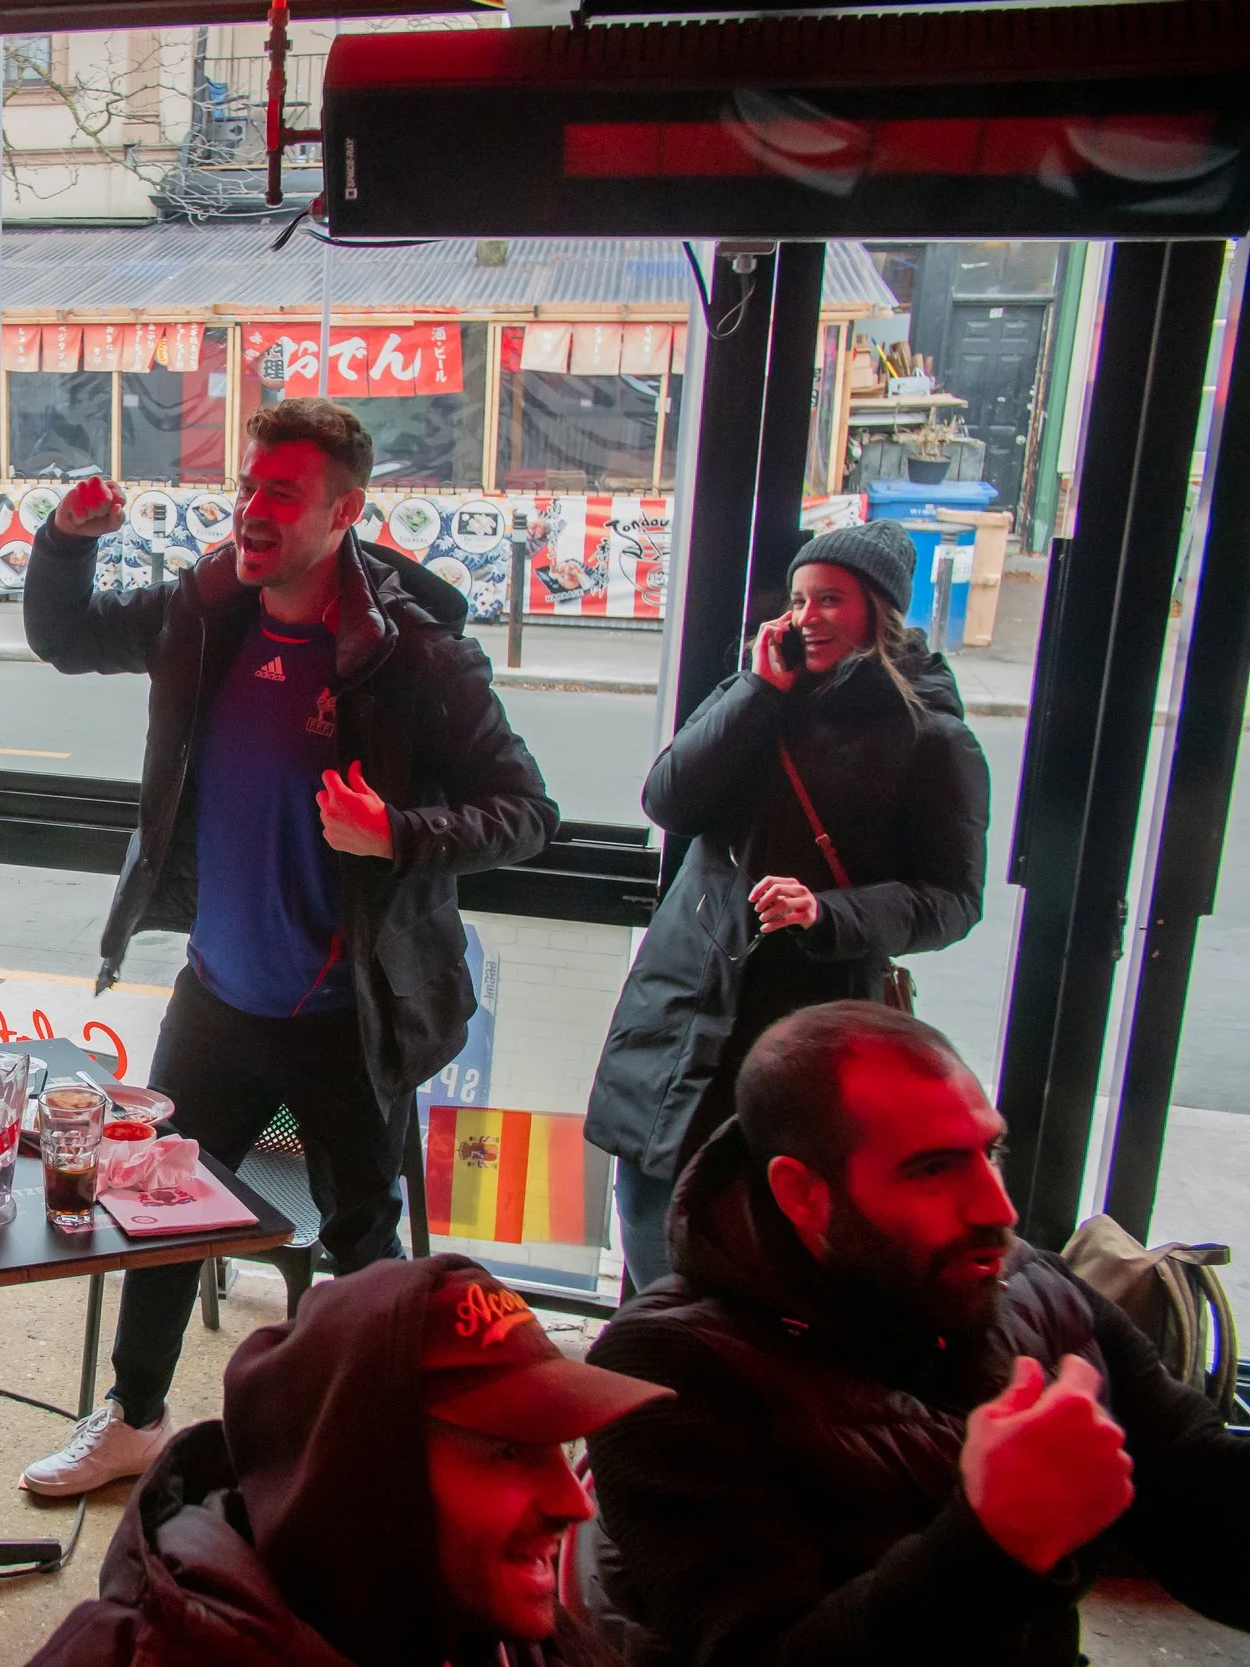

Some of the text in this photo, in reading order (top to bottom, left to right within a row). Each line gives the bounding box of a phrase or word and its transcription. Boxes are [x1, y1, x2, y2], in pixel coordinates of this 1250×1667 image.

[283, 333, 422, 381] おでん
[254, 669, 286, 682] adidas
